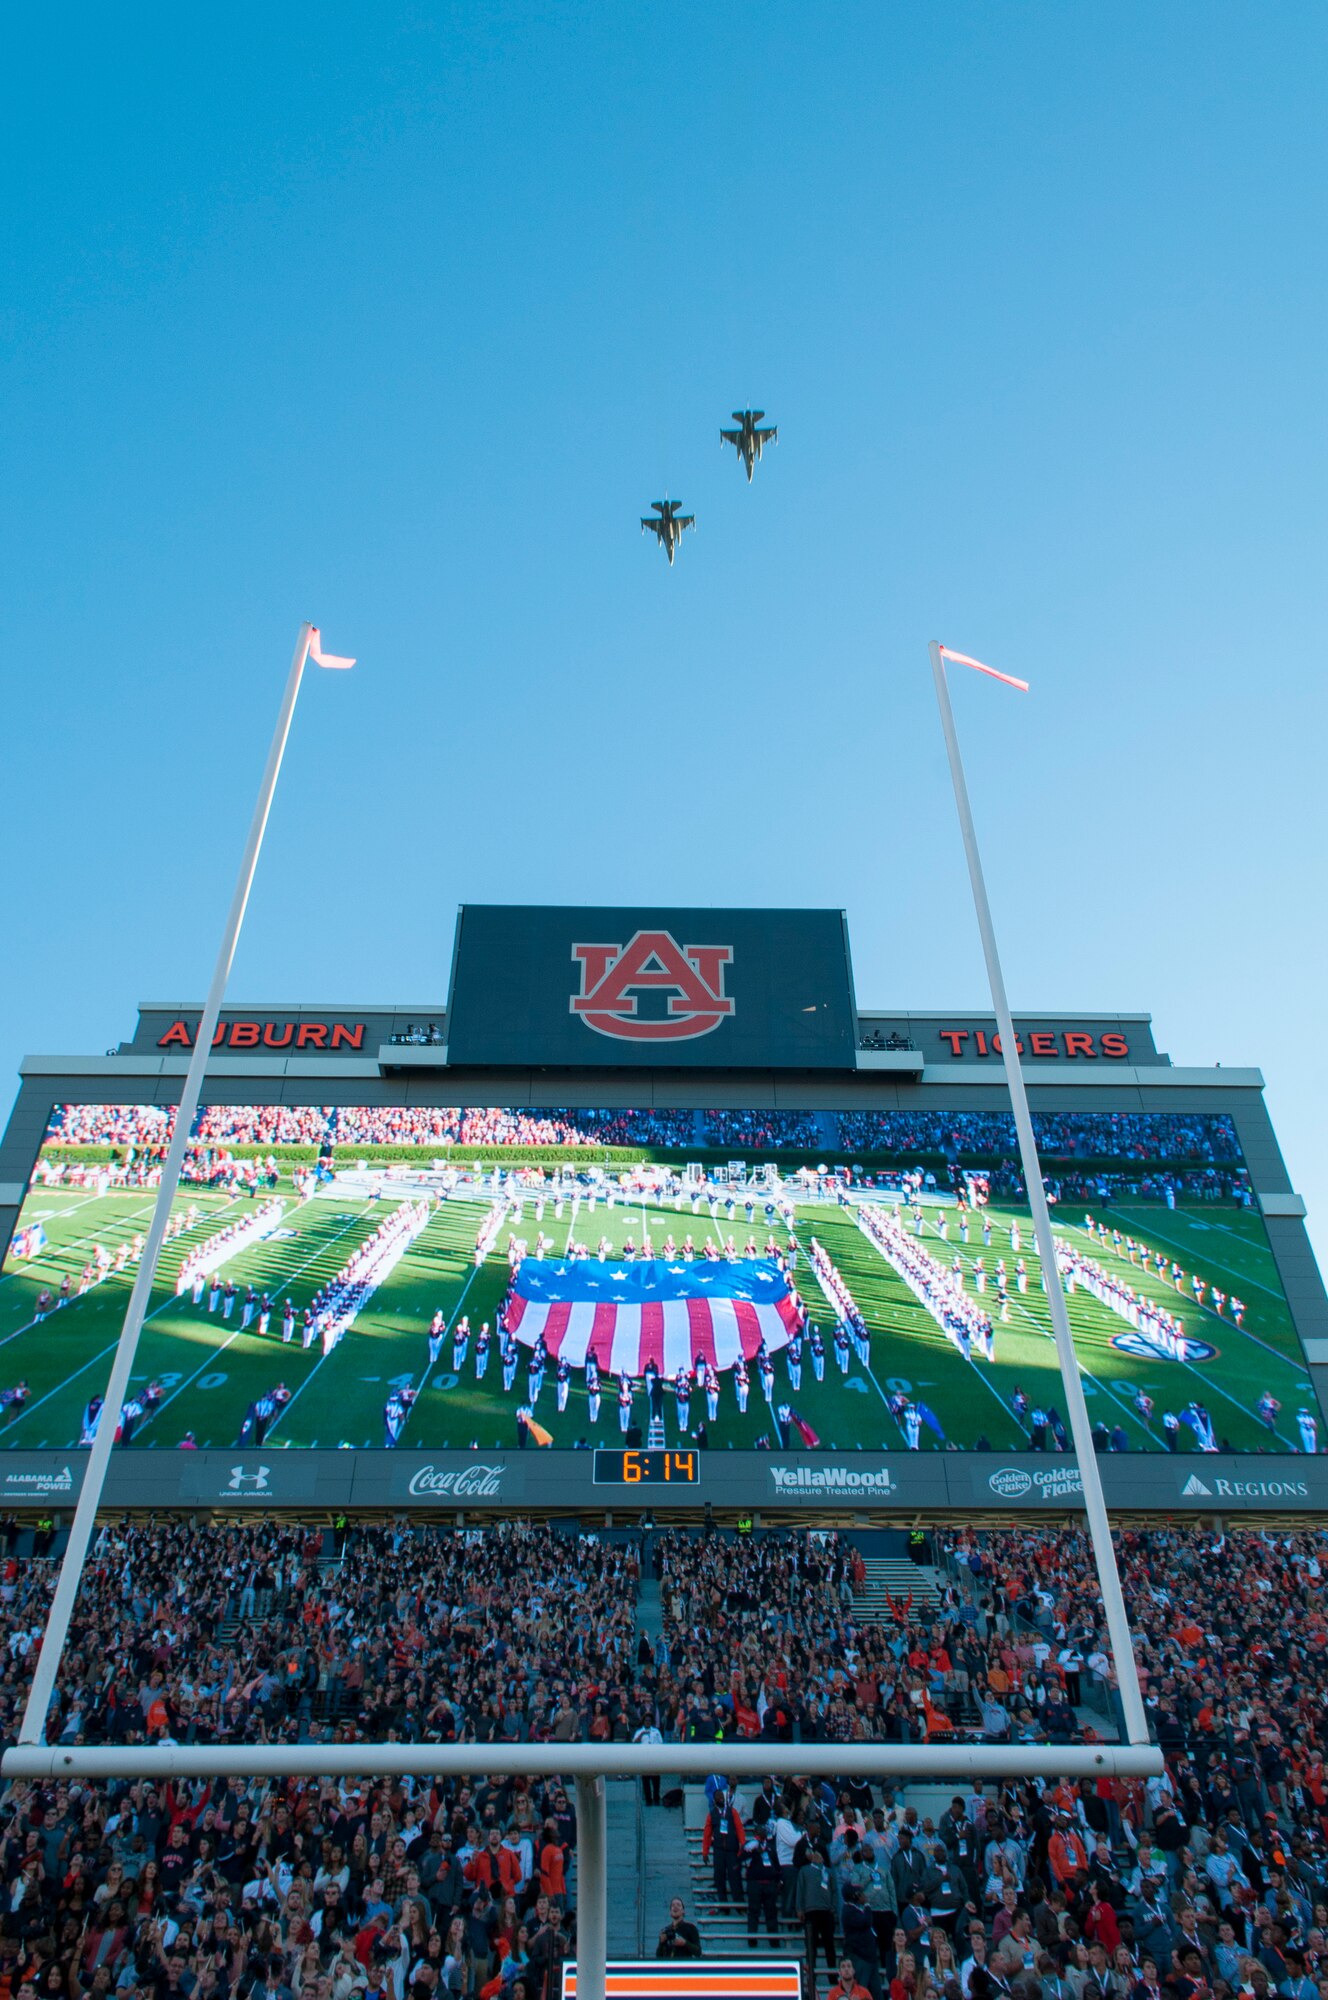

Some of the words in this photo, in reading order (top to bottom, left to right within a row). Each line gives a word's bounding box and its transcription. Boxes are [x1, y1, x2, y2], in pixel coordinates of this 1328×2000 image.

[623, 1451, 694, 1482] 6:14
[6, 1474, 53, 1482] ALABAMA
[408, 1465, 508, 1496] Coca-Cola
[991, 1473, 1029, 1485] Golden
[36, 1482, 72, 1490] POWER
[775, 1486, 822, 1495] Pressure
[826, 1486, 864, 1495] Treated
[868, 1486, 891, 1495] Pine
[997, 1482, 1029, 1492] Flake
[1042, 1480, 1084, 1498] Flake
